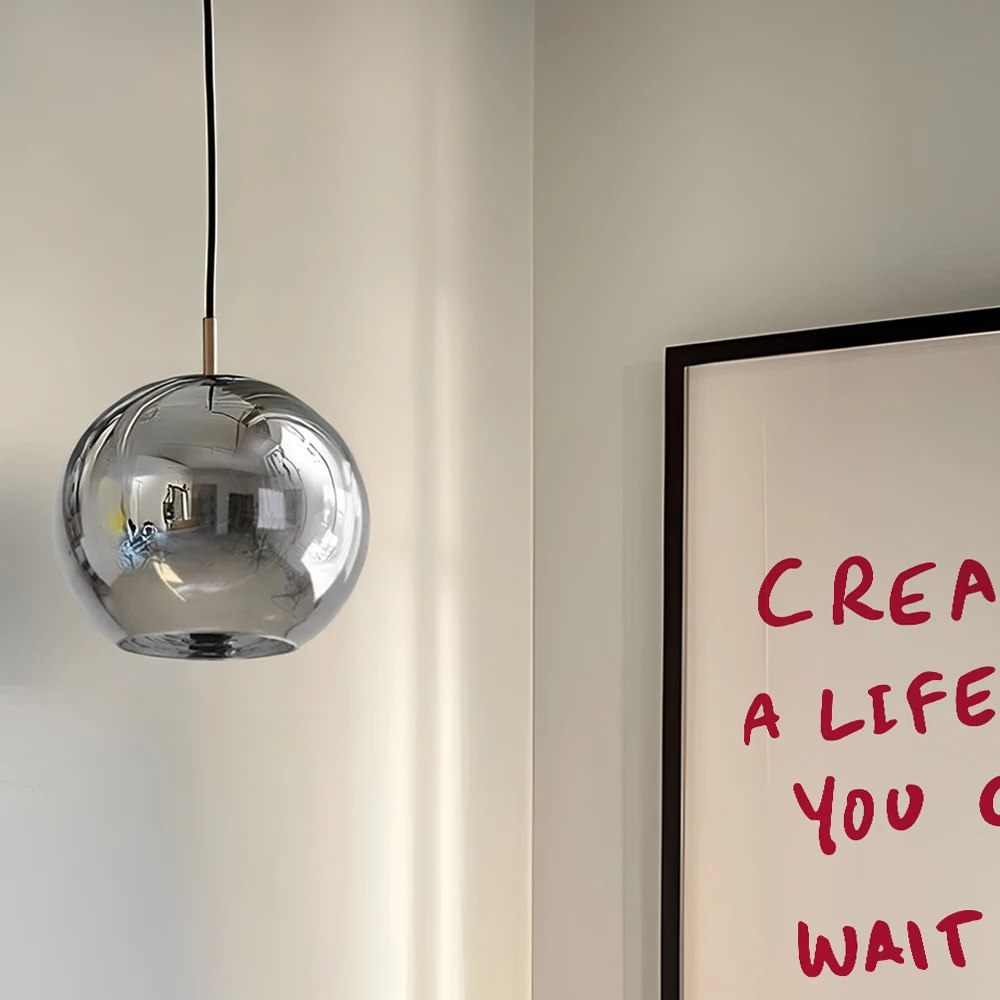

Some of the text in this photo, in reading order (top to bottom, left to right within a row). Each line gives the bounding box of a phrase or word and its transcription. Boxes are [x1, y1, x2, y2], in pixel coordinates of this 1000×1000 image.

[742, 665, 997, 747] A LIFE
[792, 775, 925, 857] YOU
[797, 909, 984, 979] WAIT
